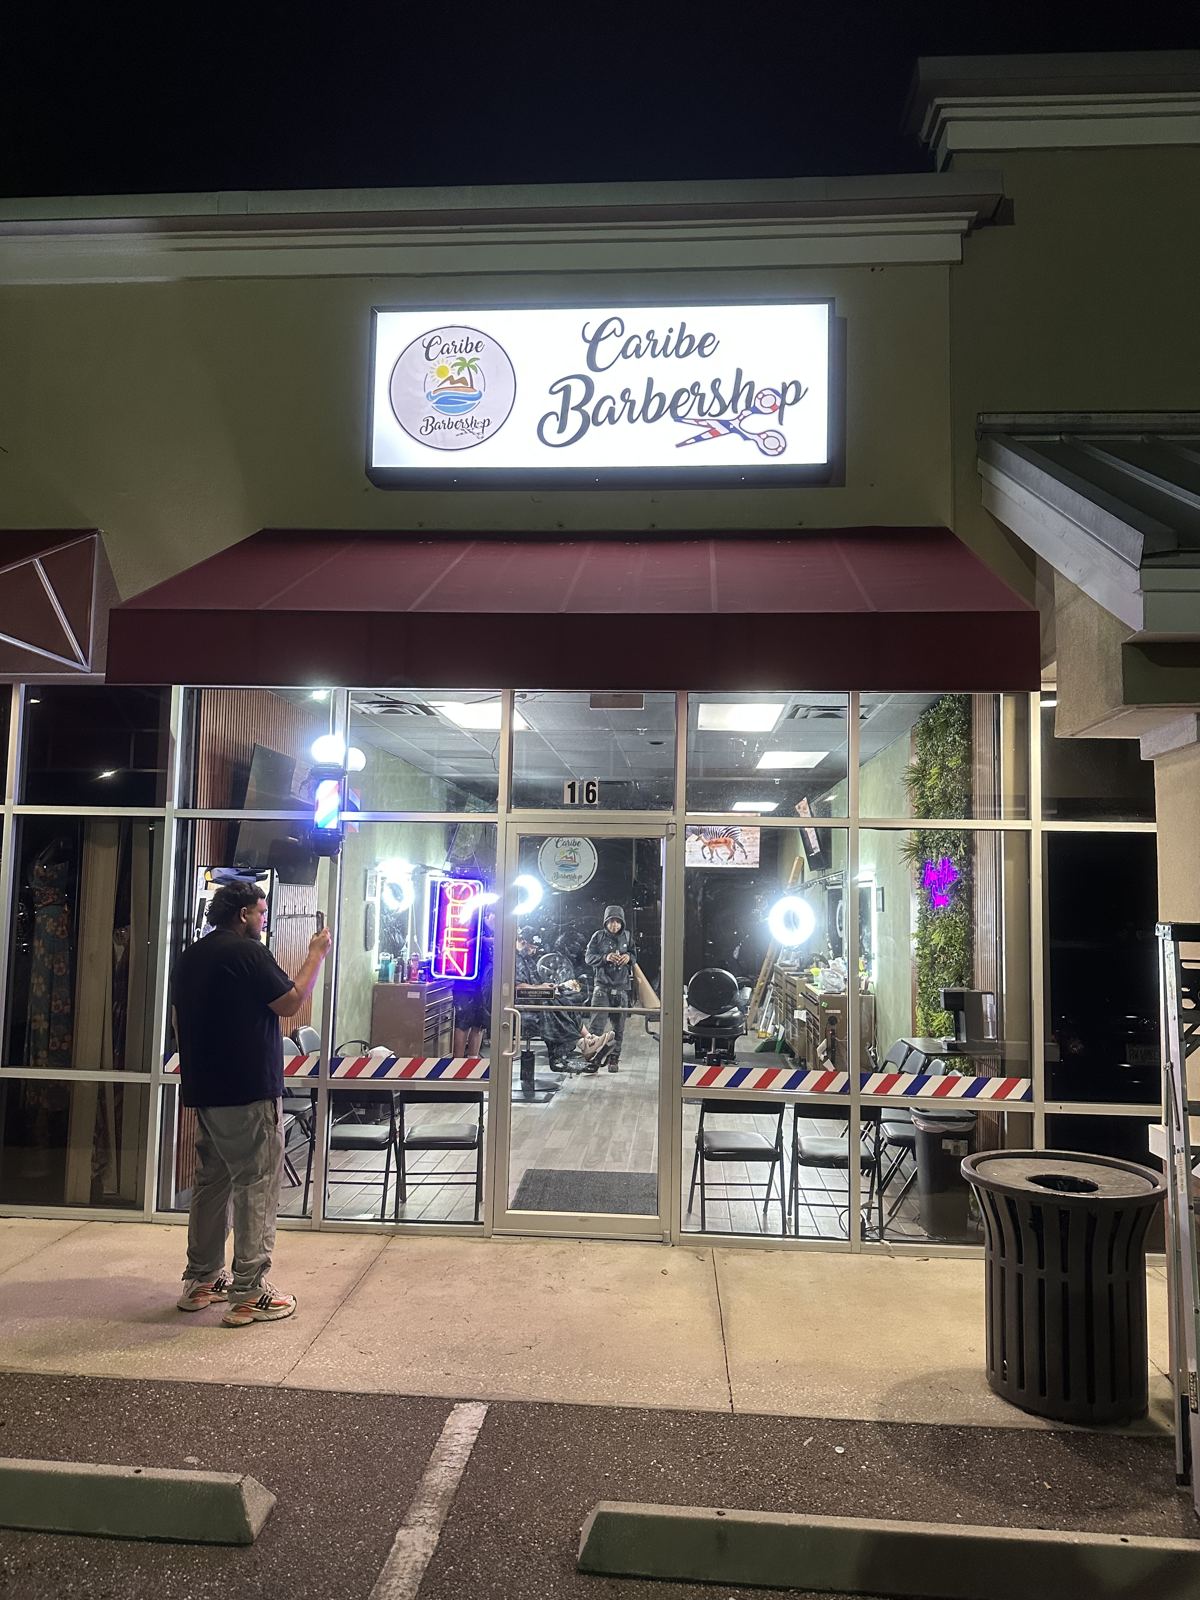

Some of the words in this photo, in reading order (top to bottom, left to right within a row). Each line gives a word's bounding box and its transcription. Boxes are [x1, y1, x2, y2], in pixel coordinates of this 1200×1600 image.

[422, 335, 485, 362] Caribe
[582, 316, 720, 373] Caribe
[420, 415, 492, 436] Barbershop
[536, 367, 809, 448] Barbershop
[567, 781, 597, 804] 16
[442, 882, 474, 977] OPEN
